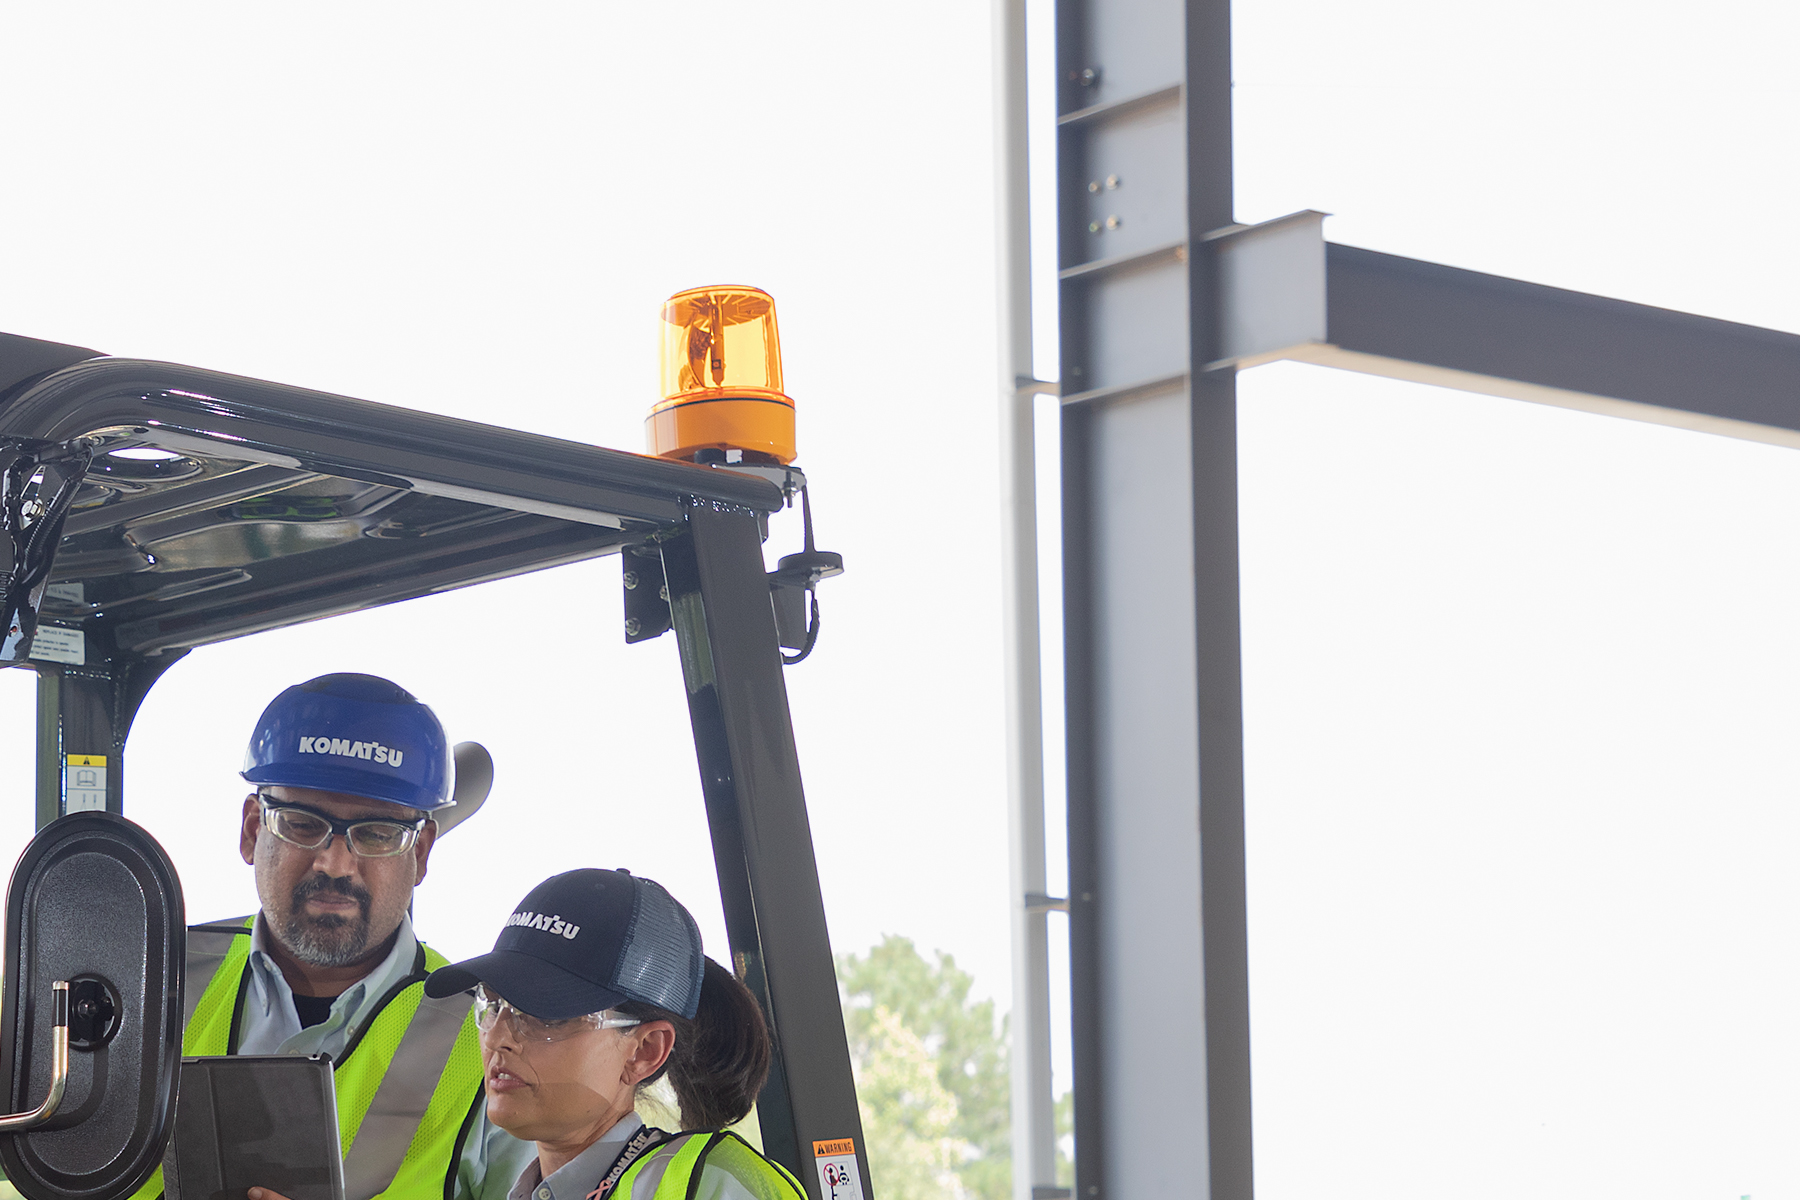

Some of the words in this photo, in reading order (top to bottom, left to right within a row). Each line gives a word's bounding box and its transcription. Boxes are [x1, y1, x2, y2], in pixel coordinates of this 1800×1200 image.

[298, 735, 404, 768] KOMATSU
[607, 1132, 648, 1181] KOMATSU
[825, 1141, 853, 1153] WARNING
